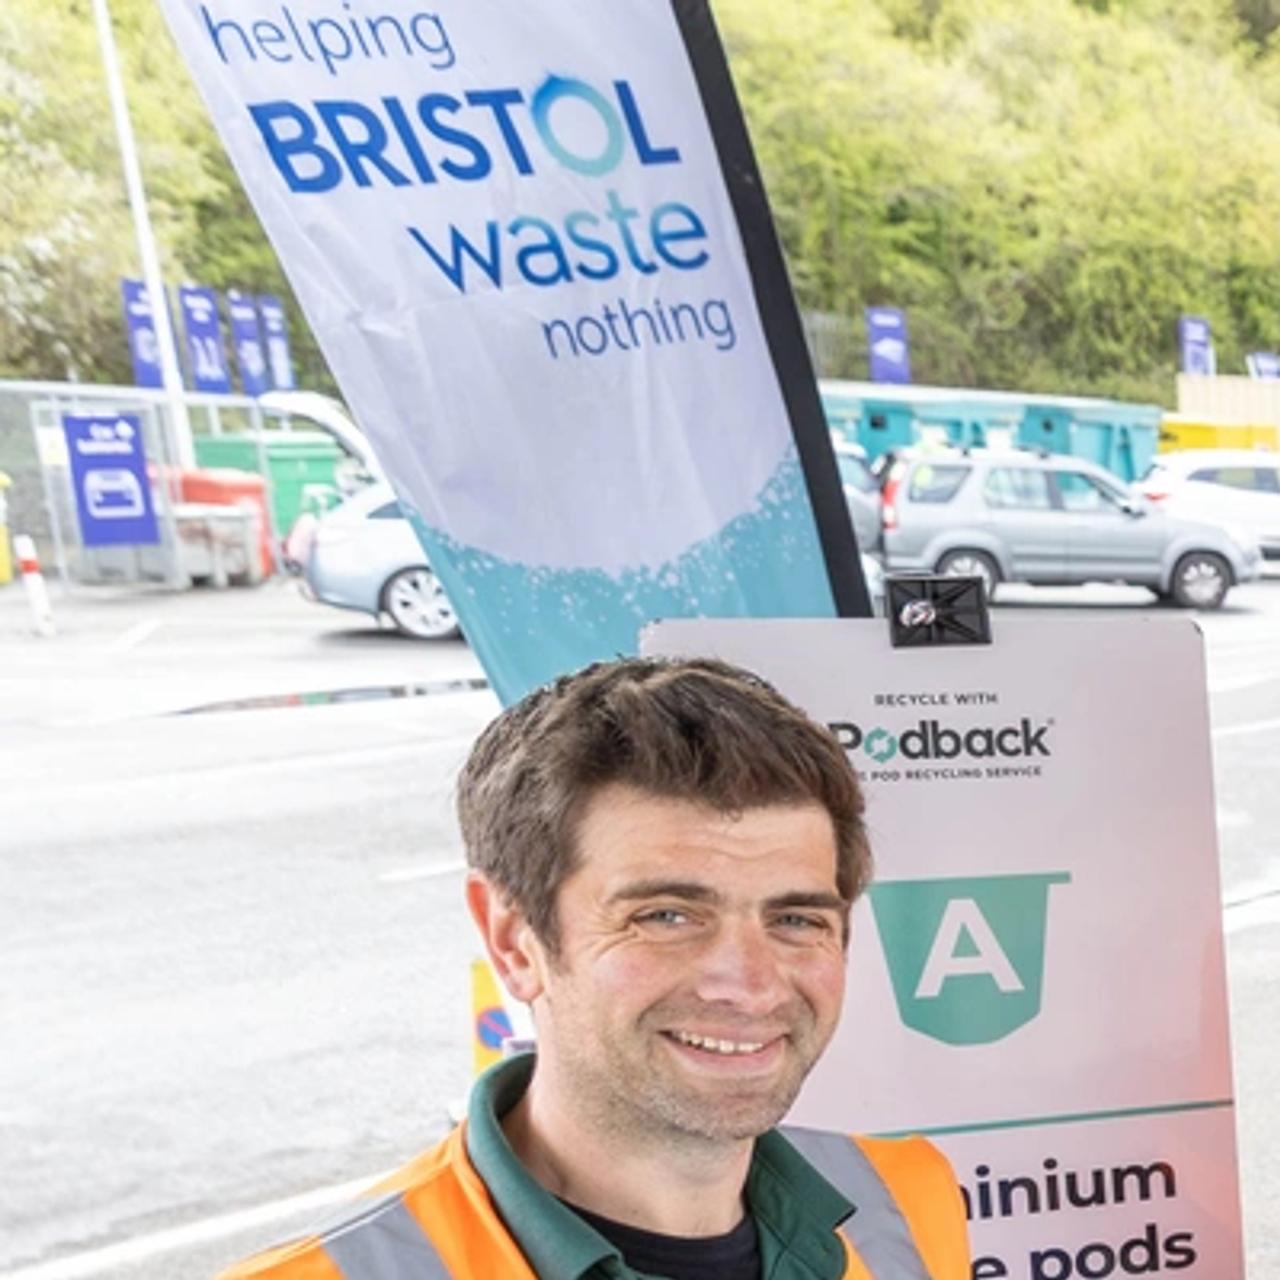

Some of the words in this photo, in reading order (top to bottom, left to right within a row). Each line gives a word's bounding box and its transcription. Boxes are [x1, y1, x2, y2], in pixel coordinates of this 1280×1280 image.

[200, 1, 456, 76] helping
[247, 74, 681, 193] BRISTOL
[407, 189, 710, 293] waste
[541, 298, 736, 359] nothing
[874, 693, 949, 706] RECYCLE
[954, 691, 998, 705] WITH
[905, 768, 983, 780] RECYCLING
[986, 766, 1042, 778] SERVICE
[915, 898, 1025, 998] A
